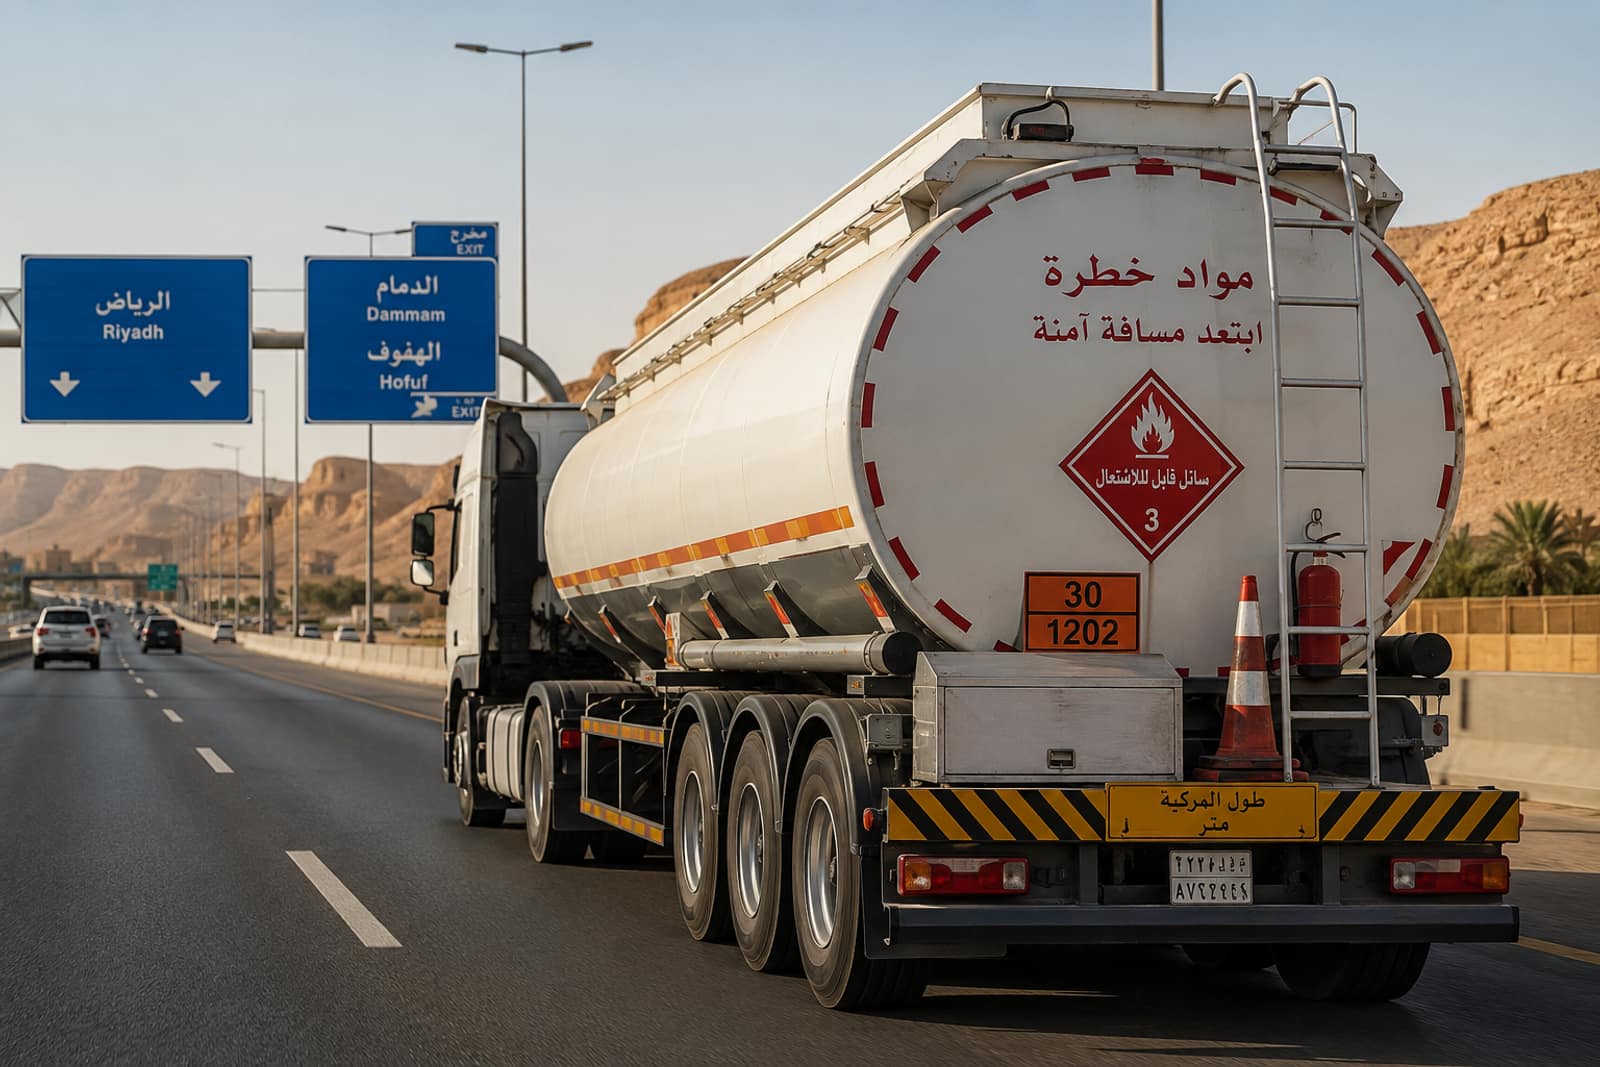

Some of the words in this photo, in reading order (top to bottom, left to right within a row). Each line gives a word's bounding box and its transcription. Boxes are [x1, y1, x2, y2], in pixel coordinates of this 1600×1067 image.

[456, 244, 484, 255] EXIT
[1043, 254, 1155, 297] خطرة
[1178, 259, 1254, 300] مواد
[376, 275, 438, 304] الدمام
[95, 290, 171, 316] الرياض
[367, 307, 446, 323] Dammam
[103, 323, 164, 343] Riyadh
[1033, 313, 1090, 342] آمنة
[1101, 315, 1185, 343] مسافة
[1198, 320, 1263, 354] ابتعد
[367, 341, 441, 367] الهفوف
[380, 374, 428, 391] Hofuf
[451, 405, 480, 418] EXIT
[1152, 468, 1177, 490] قابل
[1144, 508, 1159, 532] 3
[1064, 580, 1102, 609] 30
[1047, 618, 1119, 646] 1202
[1227, 791, 1265, 813] طول
[1198, 817, 1229, 836] متر
